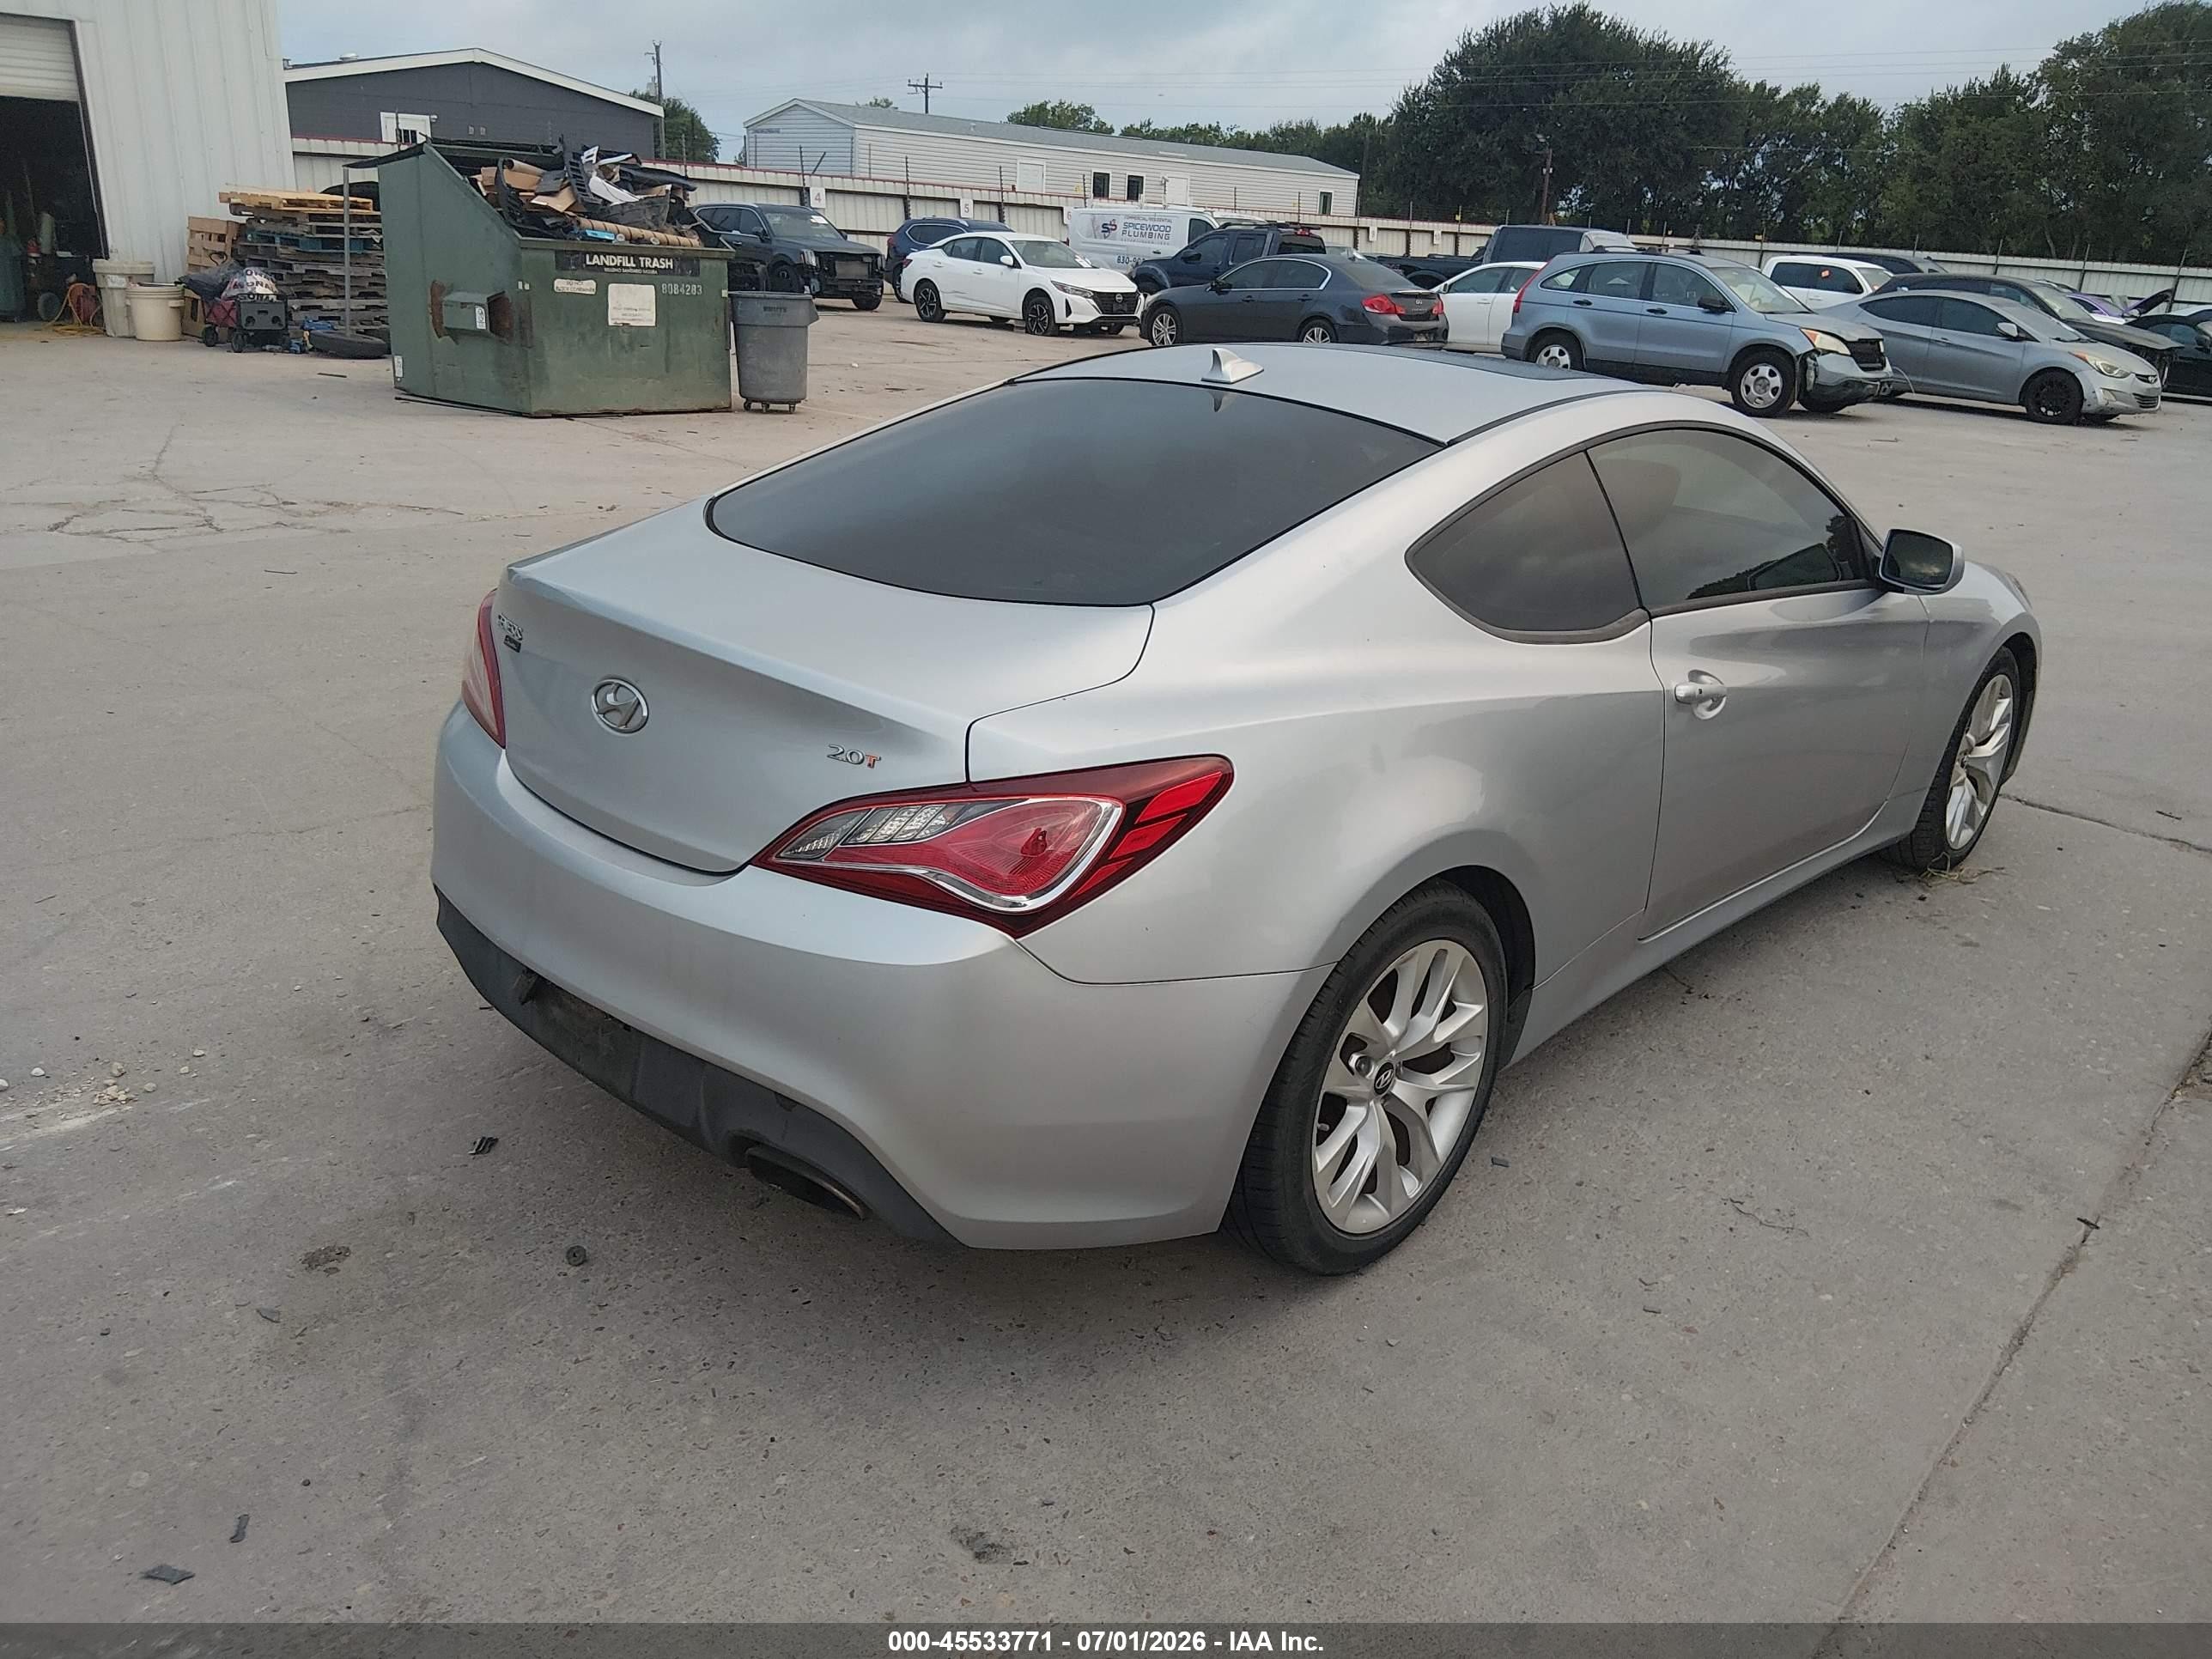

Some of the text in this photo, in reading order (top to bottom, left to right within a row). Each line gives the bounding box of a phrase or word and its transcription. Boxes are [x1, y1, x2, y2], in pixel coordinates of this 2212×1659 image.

[814, 192, 823, 203] 4
[964, 203, 969, 213] 5
[1066, 211, 1072, 220] 6
[1122, 222, 1171, 233] SPICEWOOD
[1121, 229, 1170, 240] PLUMBING
[586, 253, 673, 270] LANDFILL TRASH
